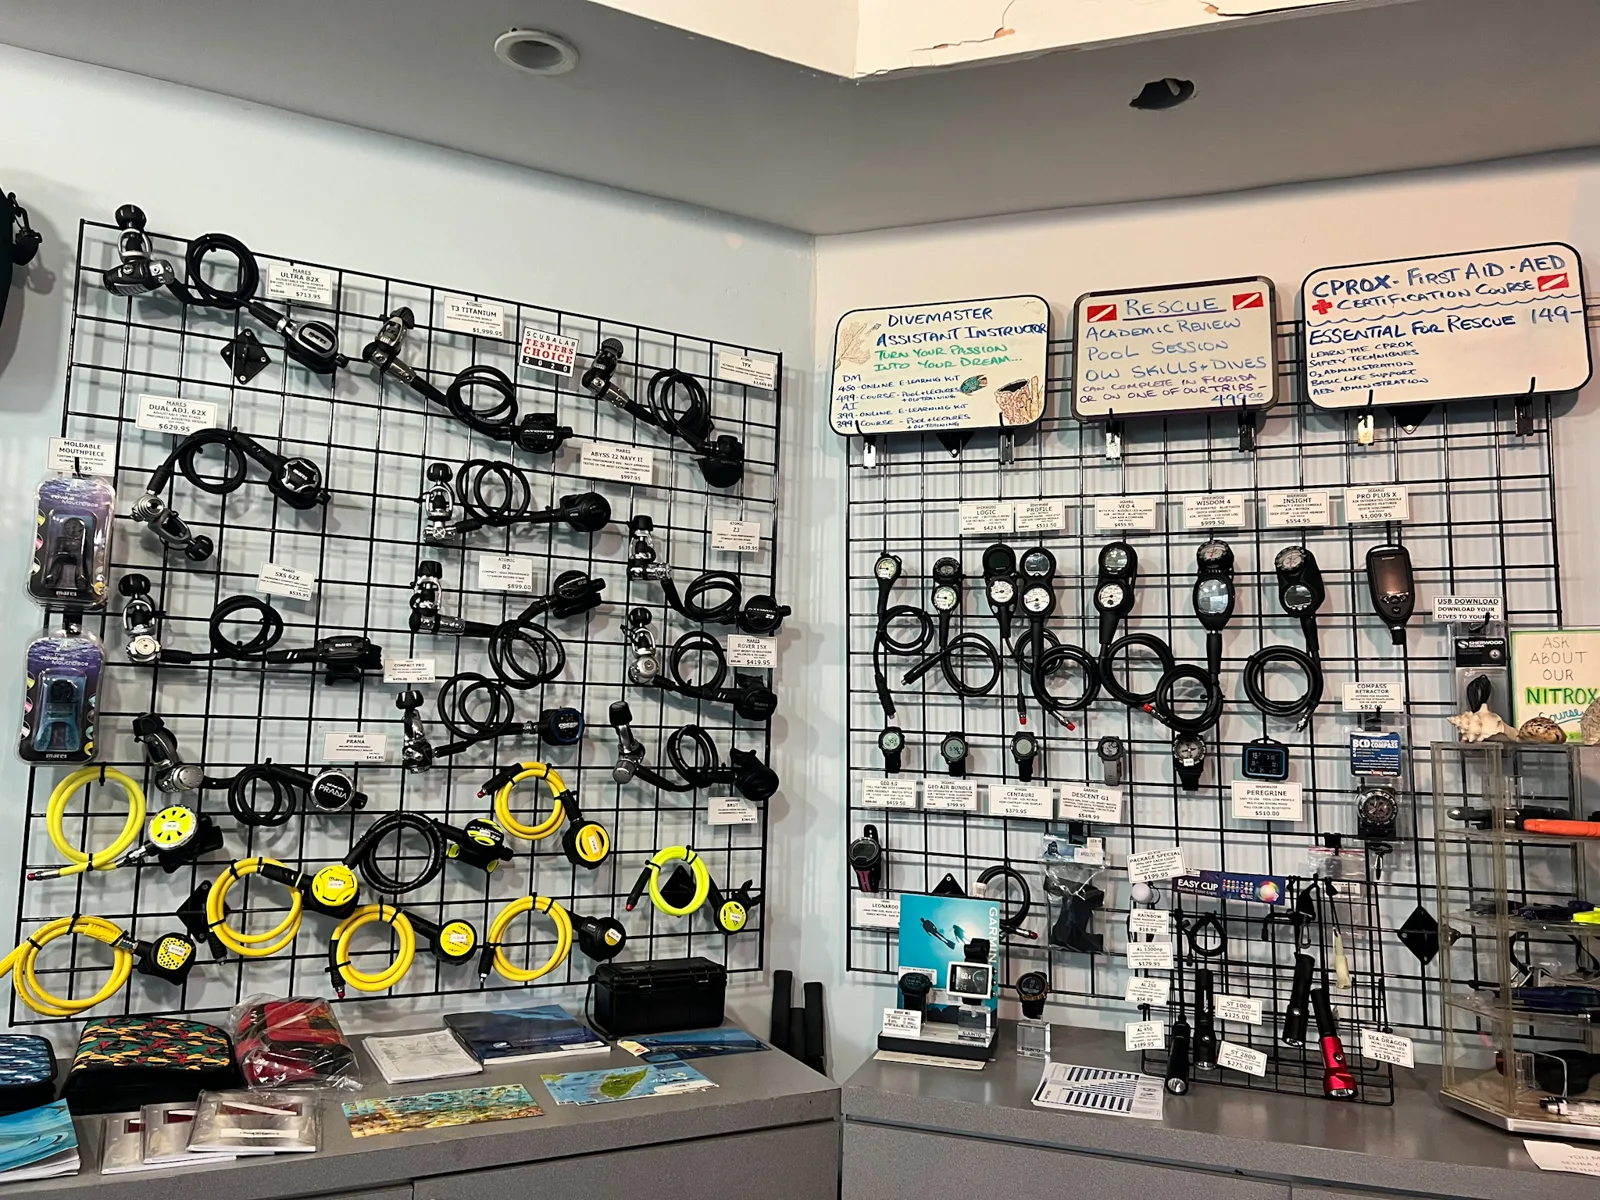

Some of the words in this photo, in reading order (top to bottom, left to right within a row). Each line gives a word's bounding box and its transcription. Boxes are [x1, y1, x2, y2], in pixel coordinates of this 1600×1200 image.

[280, 272, 304, 280] ULTRA
[1407, 268, 1460, 286] FIRST
[1465, 263, 1505, 279] AID
[1520, 255, 1565, 273] AED
[1336, 288, 1471, 310] CERTIFICATION
[1475, 281, 1535, 295] COURSE
[461, 306, 496, 317] TITANIUM
[1125, 298, 1218, 315] RESCUE
[888, 308, 993, 327] DIVEMASTER
[473, 328, 502, 336] $1,999.95
[877, 327, 961, 347] ASSISTANT
[964, 323, 1047, 338] INSTRUCTOR
[1086, 325, 1173, 341] ACADEMIC
[1177, 318, 1241, 332] REVIEW
[1309, 325, 1407, 345] ESSENTIAL
[1411, 321, 1444, 335] FOR
[1447, 315, 1516, 332] RESCUE
[526, 331, 575, 346] SCUBALAB
[526, 338, 574, 354] TESTERS
[875, 350, 909, 360] TURN
[913, 348, 946, 357] YOUR
[950, 345, 1007, 354] PASSION
[1087, 345, 1139, 361] POOL
[1152, 341, 1228, 354] SESSION
[1311, 350, 1345, 358] LEARN
[1375, 341, 1413, 349] CPROX
[523, 347, 572, 364] CHOICE
[1309, 358, 1346, 367] SAFETY
[1348, 349, 1419, 361] TECHNIQUES
[525, 358, 567, 372] 2020
[874, 363, 910, 371] INTO
[918, 360, 957, 369] YOUR
[1086, 368, 1120, 381] OW
[1132, 361, 1197, 378] SKILLS
[1211, 356, 1266, 370] DIVES
[843, 374, 861, 382] DM
[1370, 369, 1416, 378] SUPPORT
[1111, 379, 1173, 390] COMPLETE
[1202, 374, 1257, 384] FLORIDA
[1340, 377, 1429, 392] ADMINISTRATION
[860, 392, 896, 400] COURSE
[1128, 390, 1157, 398] ONE
[1209, 384, 1253, 392] TRIPS
[149, 404, 169, 412] DUAL
[842, 402, 859, 410] AI
[159, 423, 190, 432] $629.95
[64, 441, 101, 449] MOLDABLE
[59, 448, 104, 457] MOUTHPIECE
[1543, 637, 1570, 648] ASK
[1530, 651, 1587, 664] ABOUT
[1543, 669, 1574, 681] OUR
[1527, 688, 1598, 704] NITROX
[1353, 739, 1370, 748] BCD
[1072, 792, 1099, 800] DESCENT
[1178, 879, 1199, 887] EASY
[1201, 882, 1218, 891] CUP
[988, 906, 998, 963] GARMIN
[1225, 1012, 1249, 1020] $125.00
[1381, 1038, 1407, 1047] DRAGON
[1241, 1052, 1256, 1060] 2800
[1228, 1060, 1253, 1071] $275.00
